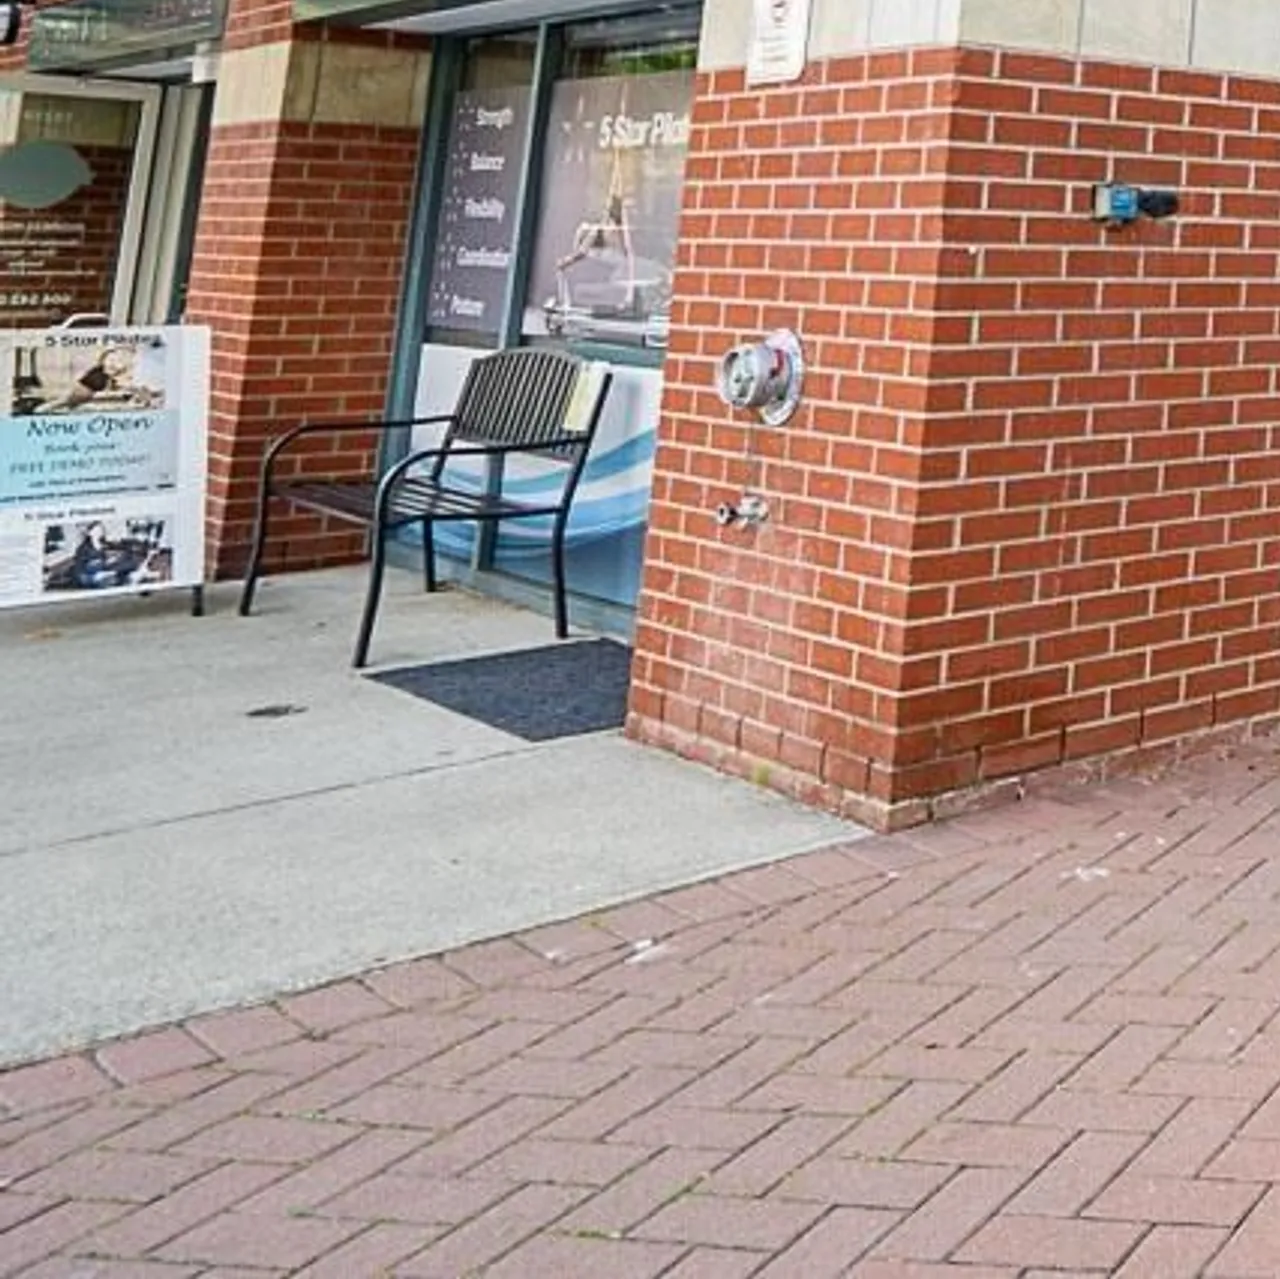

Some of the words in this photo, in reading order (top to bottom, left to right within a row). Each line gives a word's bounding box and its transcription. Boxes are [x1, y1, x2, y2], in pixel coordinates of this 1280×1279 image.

[599, 114, 613, 150] 5
[612, 114, 652, 148] Star
[60, 334, 98, 348] Star
[26, 418, 80, 438] Now
[87, 415, 154, 438] Open
